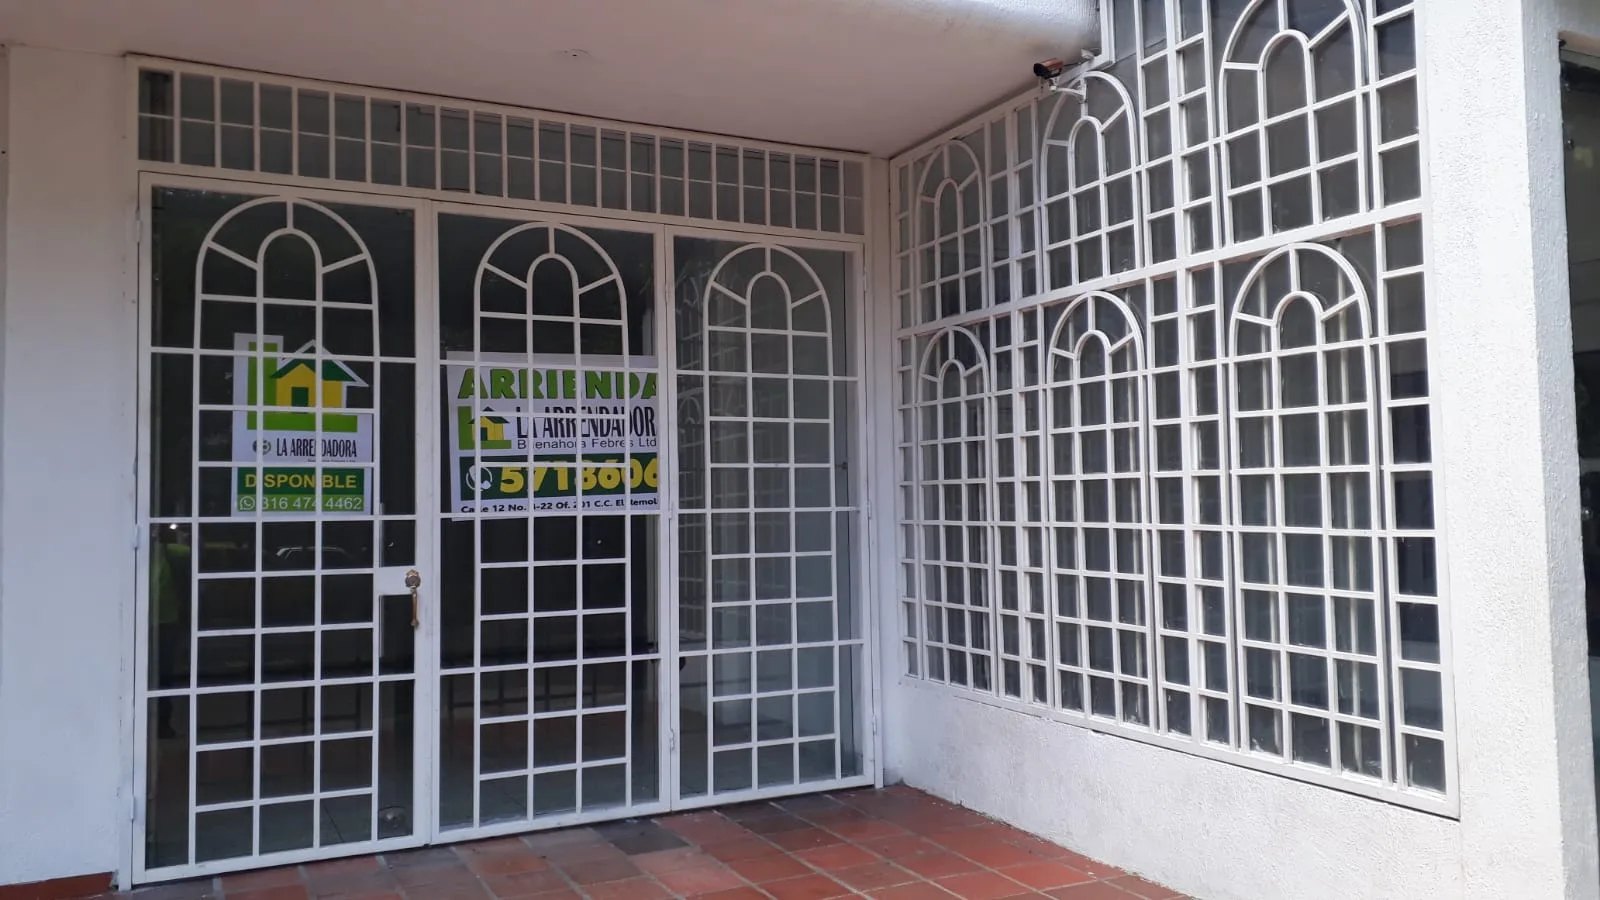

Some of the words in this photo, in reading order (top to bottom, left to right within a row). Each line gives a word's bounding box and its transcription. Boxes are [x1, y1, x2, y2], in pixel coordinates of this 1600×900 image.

[277, 438, 288, 456] LA
[290, 439, 357, 457] ARREDADORA
[592, 438, 634, 448] Febres
[245, 474, 357, 488] DSPONBLE
[326, 497, 361, 509] 4462
[461, 505, 489, 513] Cae
[492, 504, 505, 512] 12
[533, 502, 553, 510] -22
[556, 501, 570, 509] Of.
